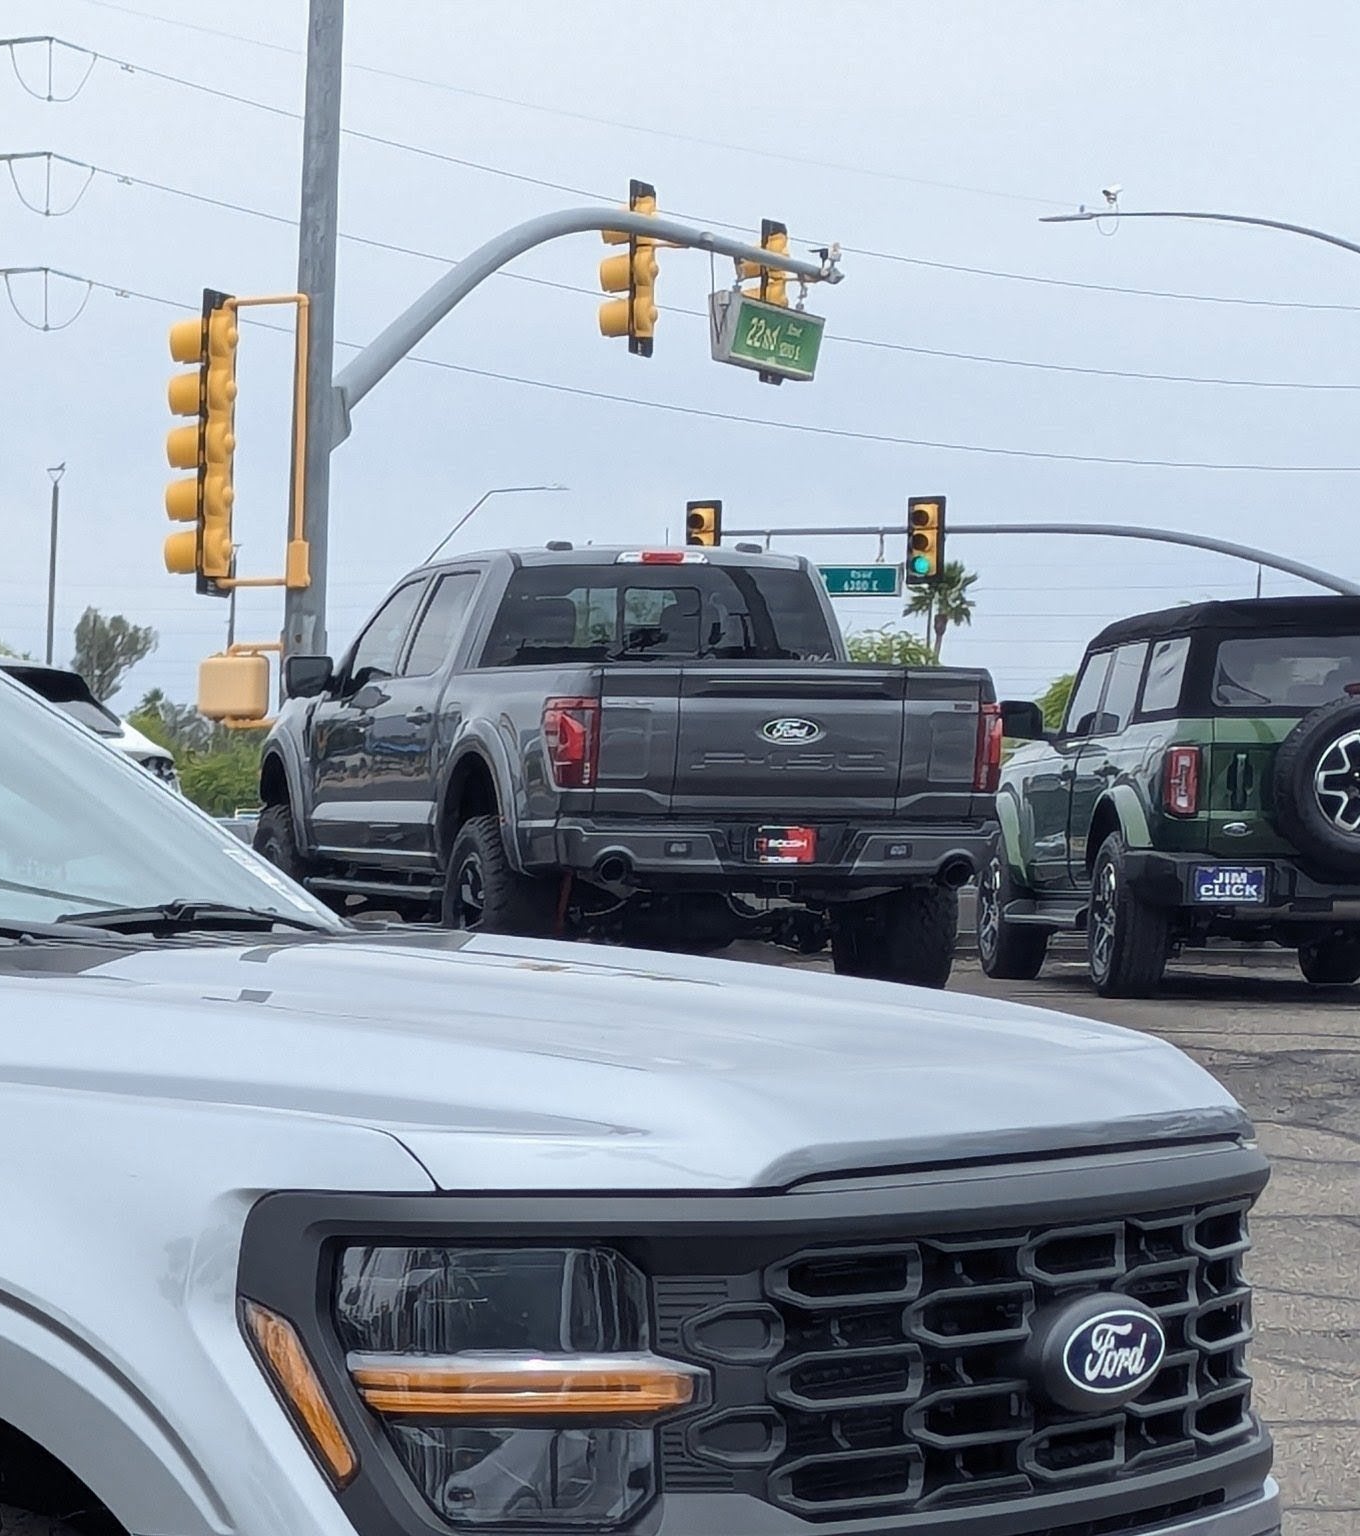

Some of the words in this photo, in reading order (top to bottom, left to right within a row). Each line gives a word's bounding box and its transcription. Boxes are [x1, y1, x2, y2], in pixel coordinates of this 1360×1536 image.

[1213, 872, 1247, 884] JIM
[1200, 884, 1258, 896] CLICK
[1084, 1323, 1147, 1381] Ford
